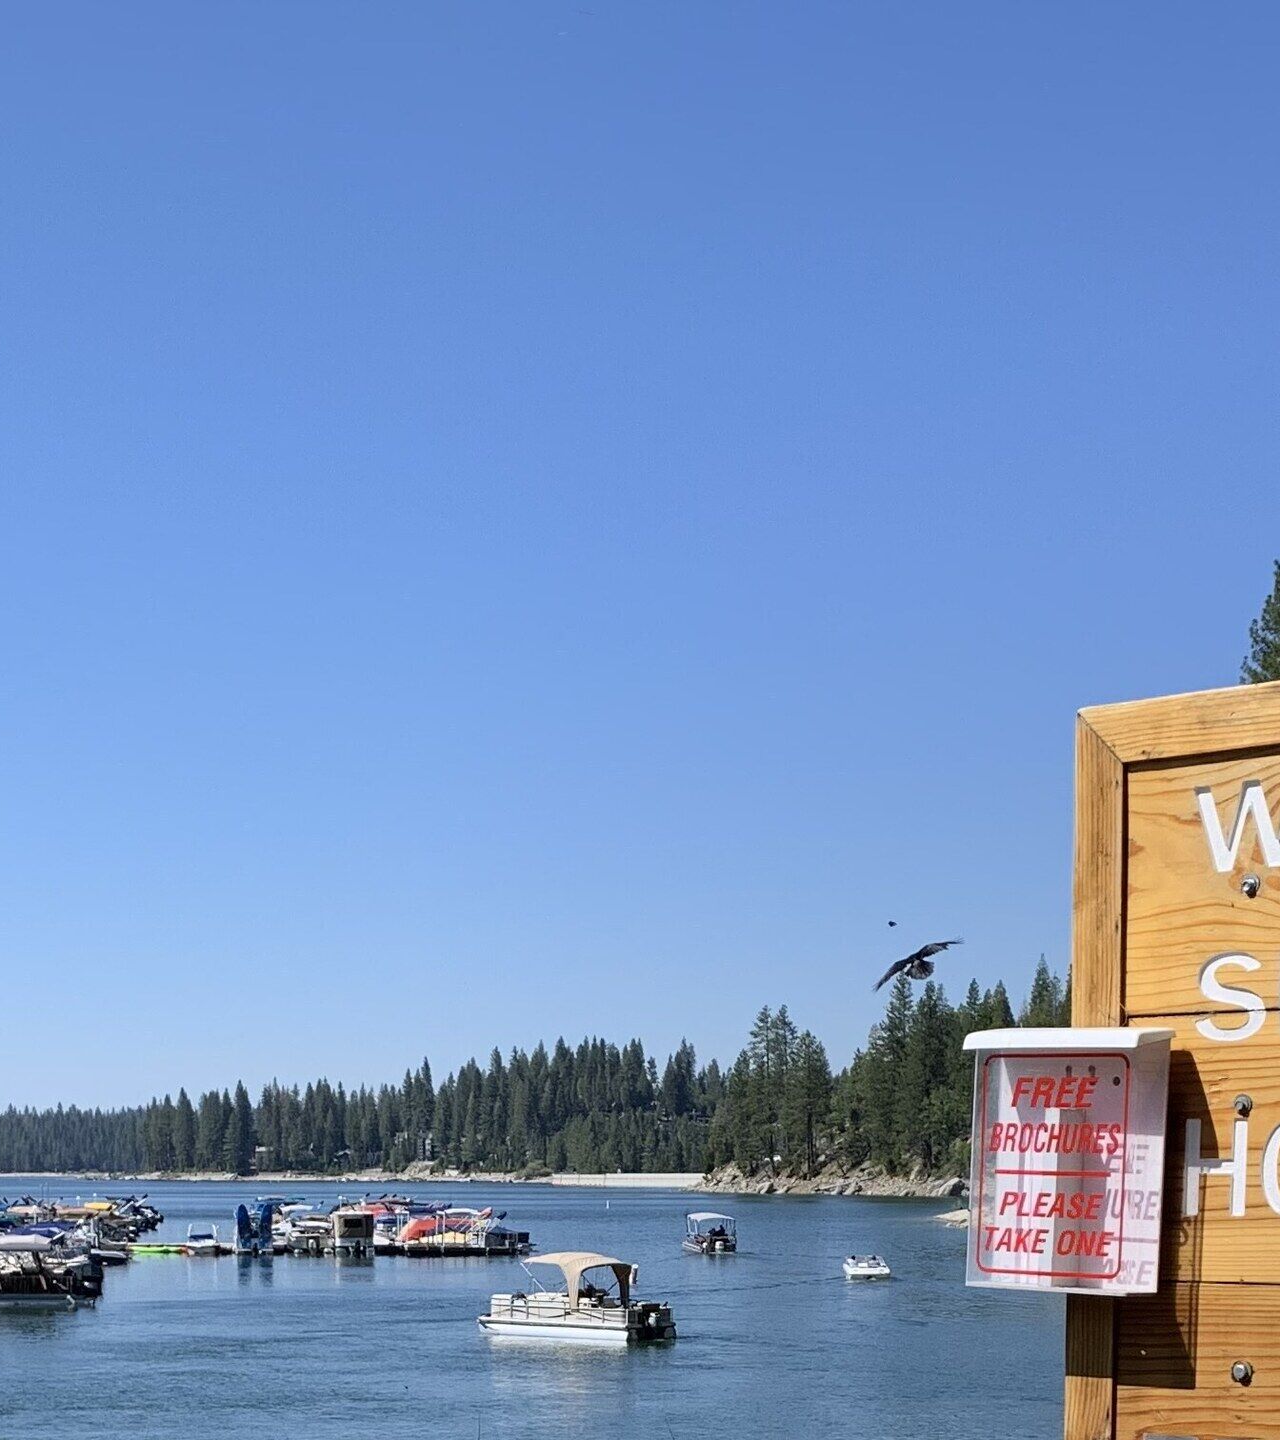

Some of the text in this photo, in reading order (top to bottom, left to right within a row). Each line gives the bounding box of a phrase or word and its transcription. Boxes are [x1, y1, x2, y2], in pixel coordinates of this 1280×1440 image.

[1011, 1075, 1098, 1108] FREE
[989, 1122, 1120, 1154] BROCHURES
[999, 1191, 1104, 1220] PLEASE
[985, 1226, 1114, 1257] TAKE ONE
